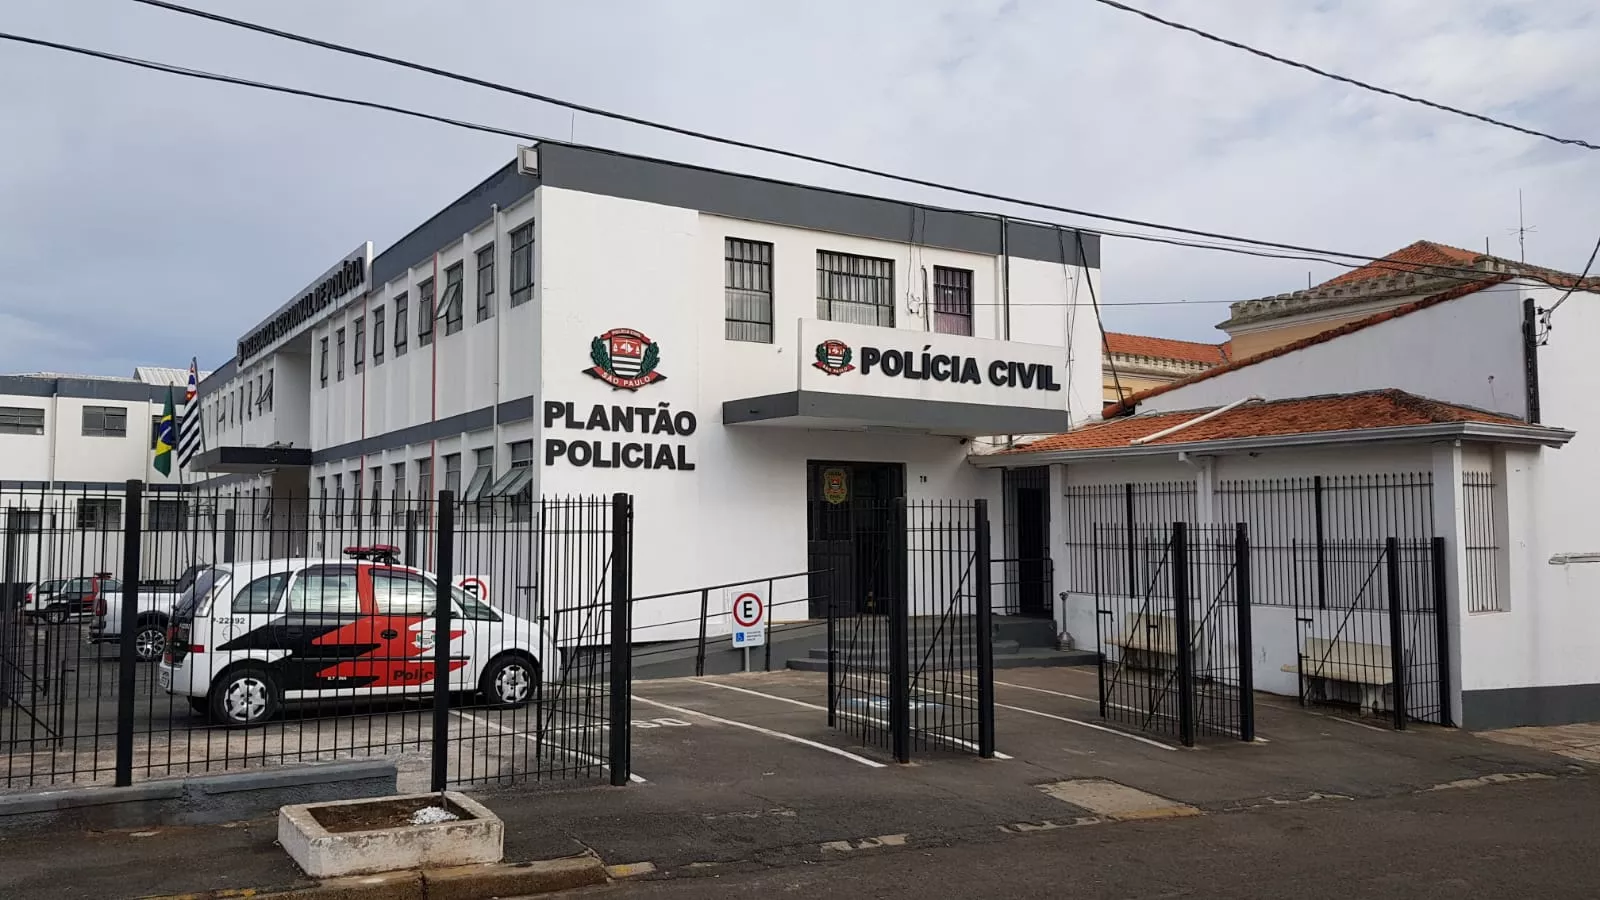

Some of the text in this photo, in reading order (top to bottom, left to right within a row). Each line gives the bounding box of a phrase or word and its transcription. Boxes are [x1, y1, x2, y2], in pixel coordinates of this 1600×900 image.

[326, 256, 364, 304] POLÍCIA
[623, 375, 650, 387] PAULO
[860, 345, 1061, 392] POLÍCIA CIVIL
[543, 400, 697, 437] PLANTÃO
[545, 438, 695, 471] POLICIAL
[743, 600, 753, 618] E
